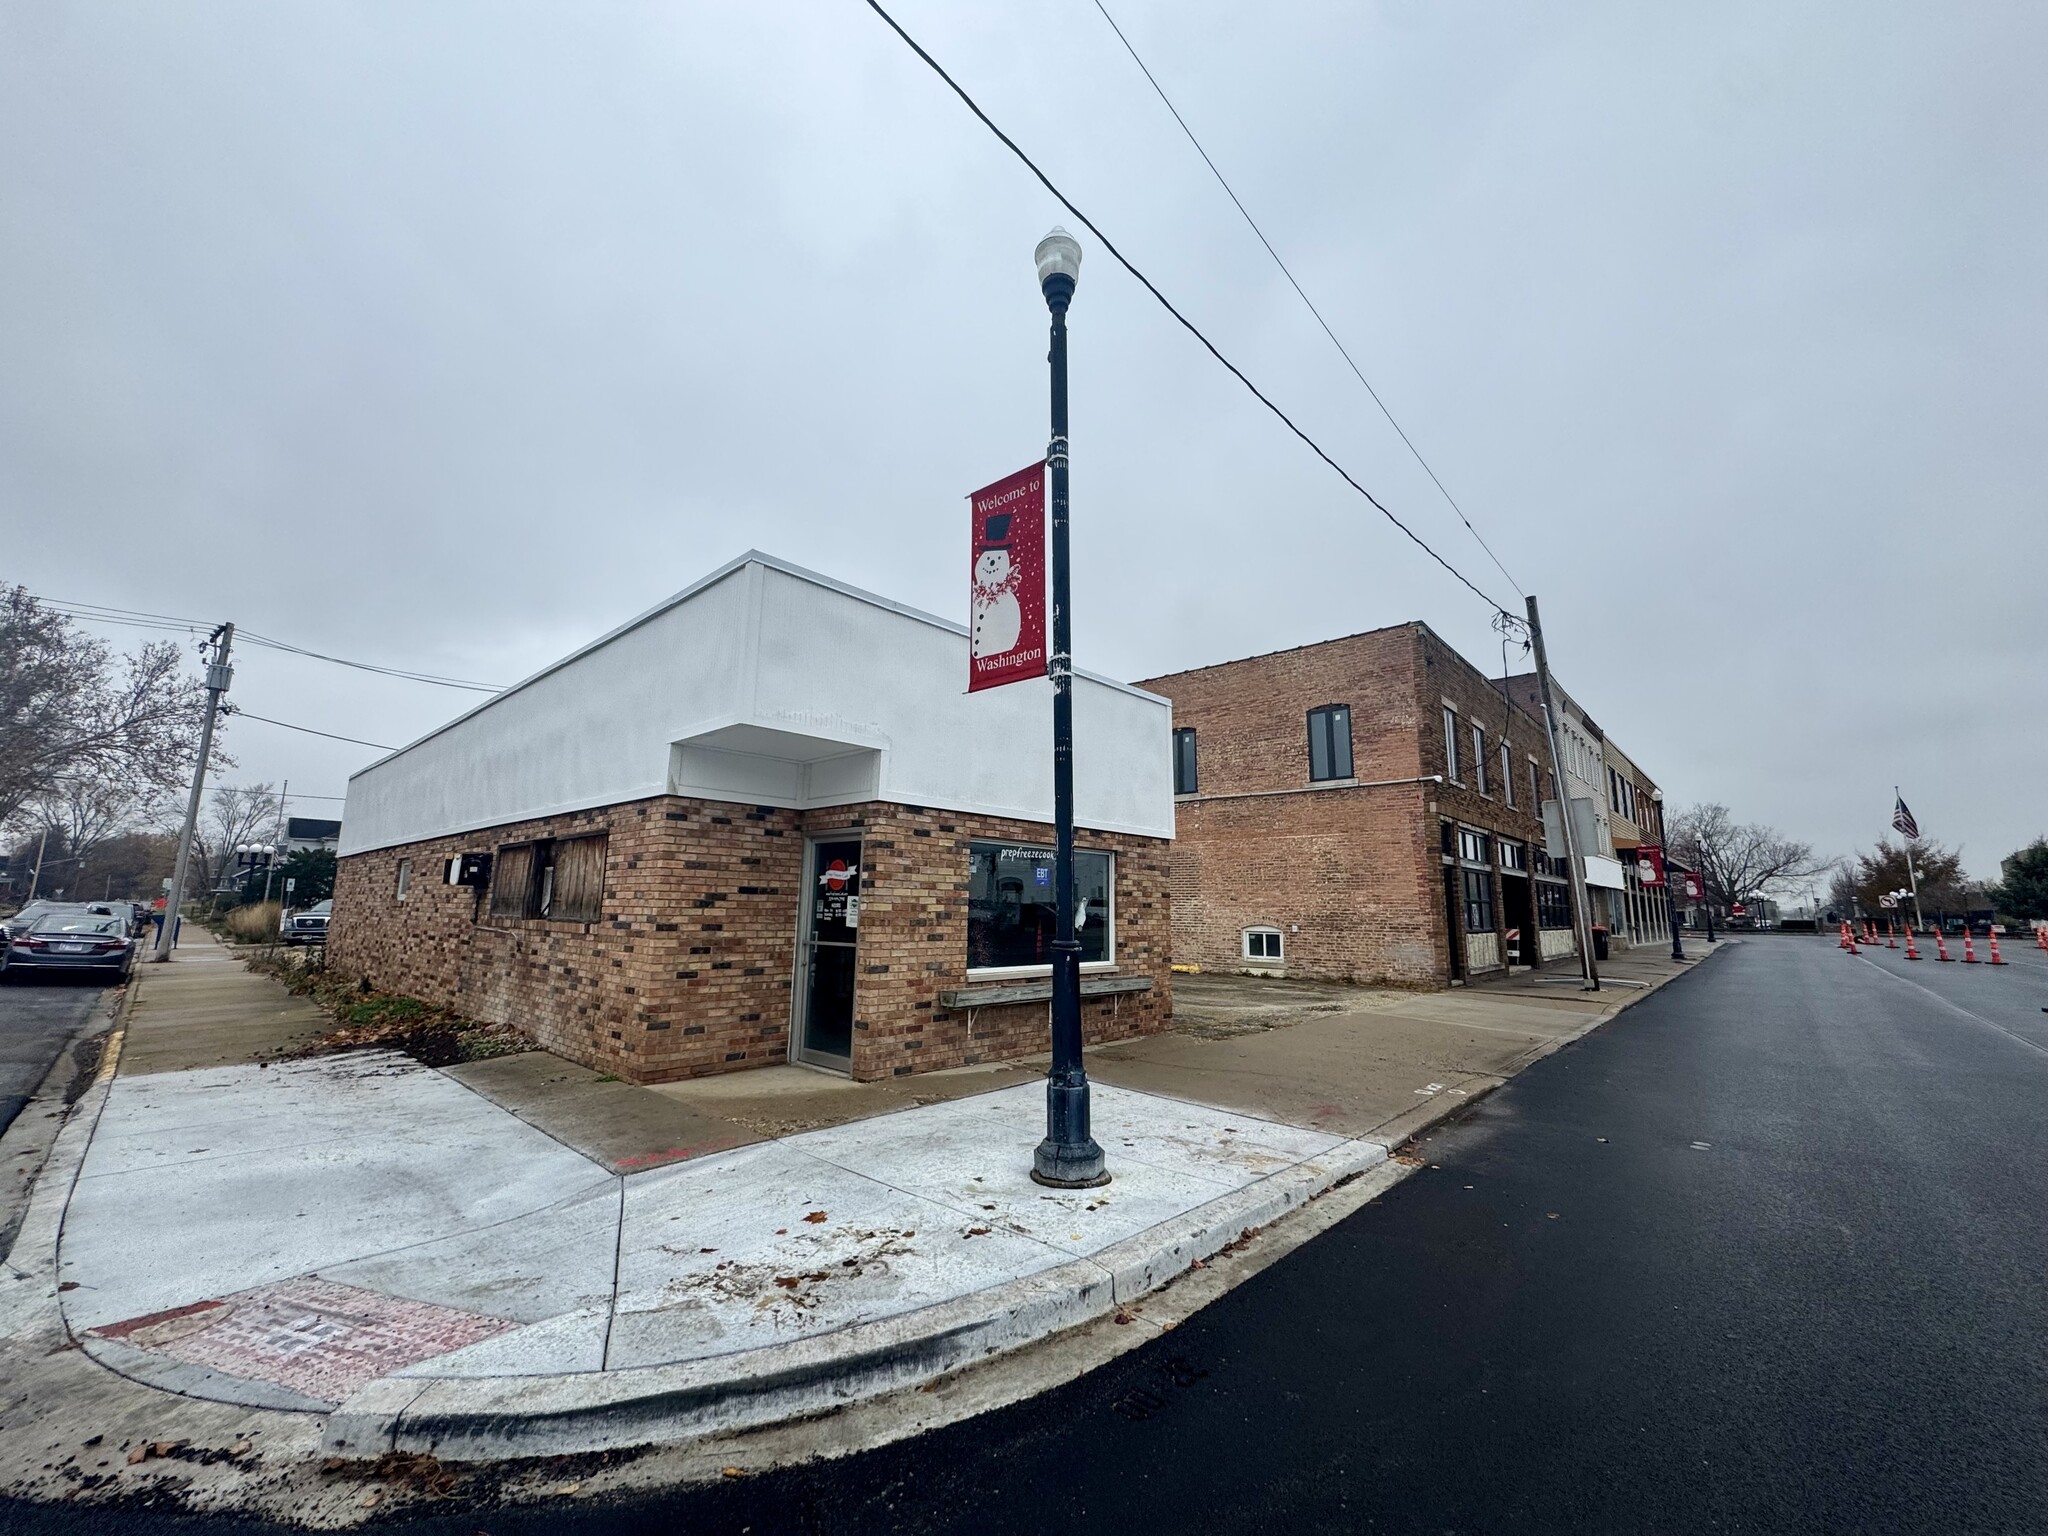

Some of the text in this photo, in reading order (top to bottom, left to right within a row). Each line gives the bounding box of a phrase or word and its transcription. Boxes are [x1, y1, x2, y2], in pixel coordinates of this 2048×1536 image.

[977, 480, 1040, 513] Welcome to
[976, 647, 1041, 673] Washington
[1036, 868, 1049, 878] EBT
